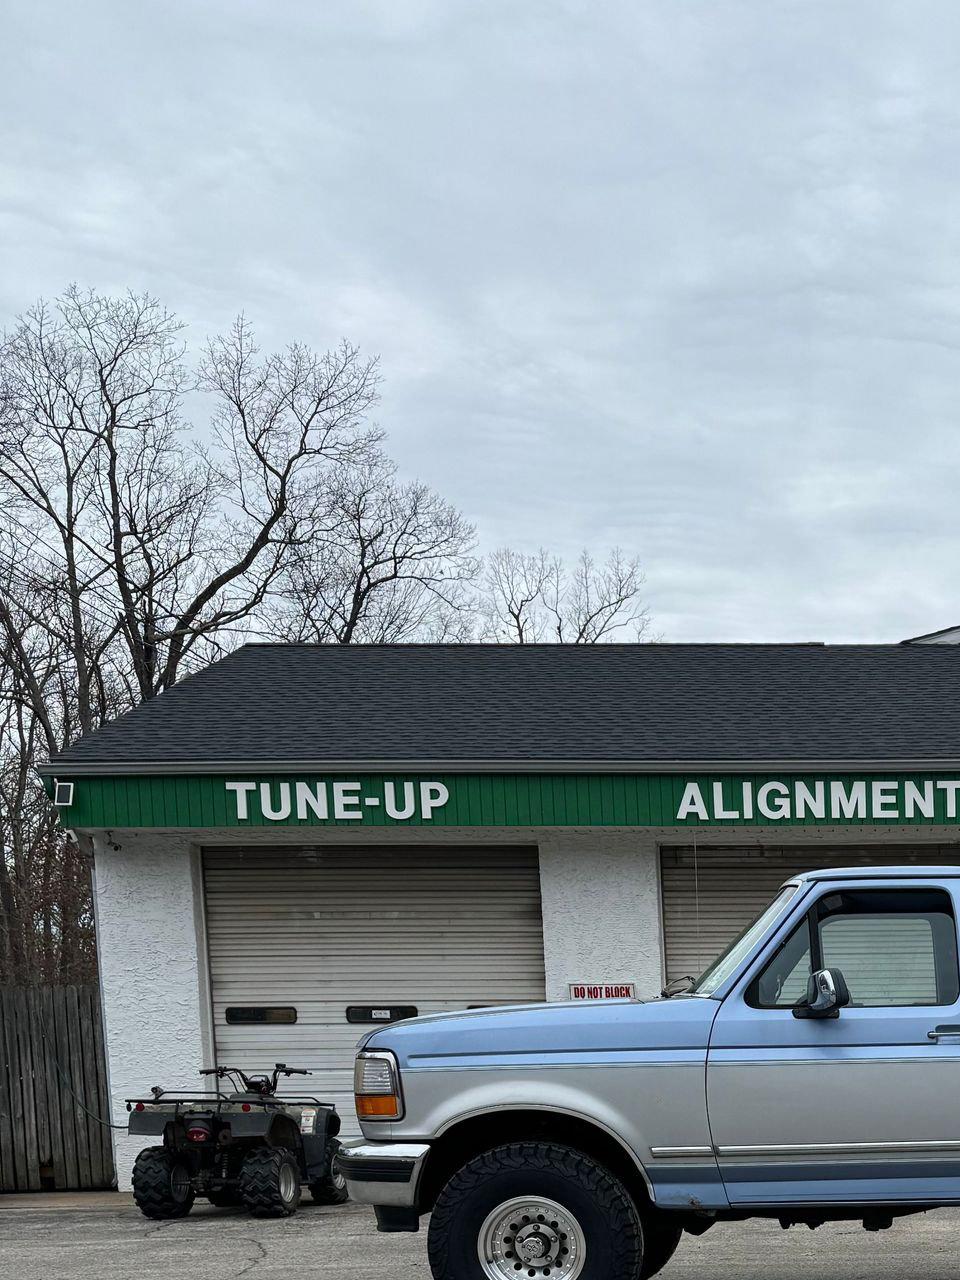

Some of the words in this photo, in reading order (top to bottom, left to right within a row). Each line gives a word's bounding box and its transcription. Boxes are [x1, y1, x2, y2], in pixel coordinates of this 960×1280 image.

[225, 781, 449, 820] TUNE-UP
[574, 986, 585, 999] DO
[587, 986, 603, 999] NOT
[605, 986, 631, 998] BLOCK
